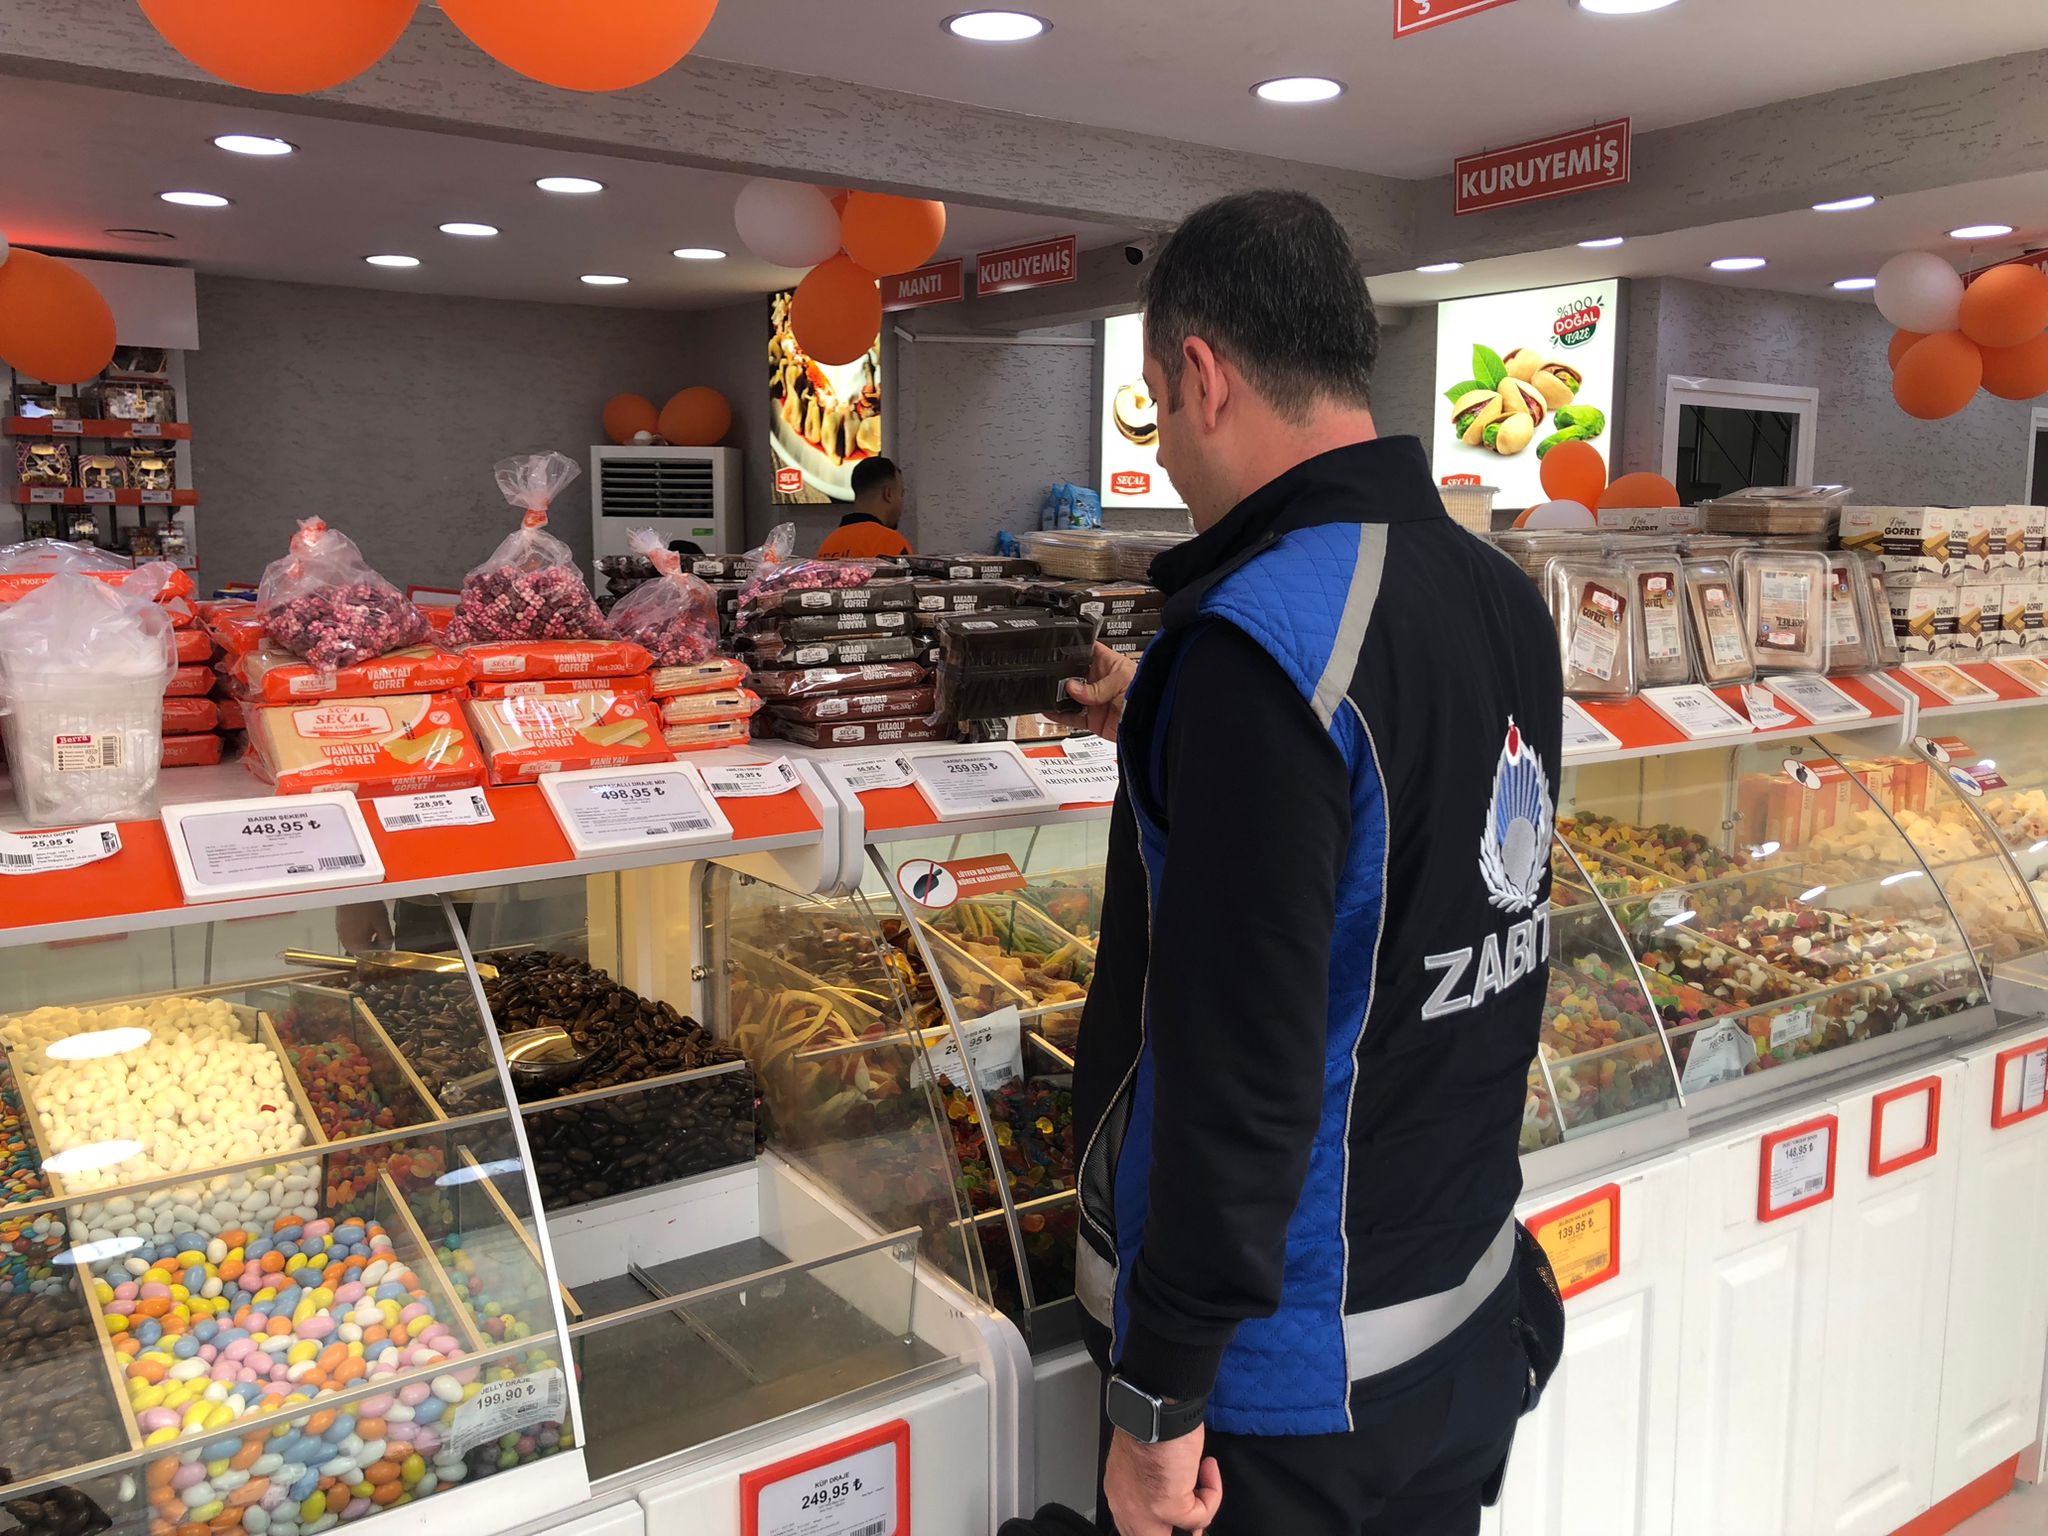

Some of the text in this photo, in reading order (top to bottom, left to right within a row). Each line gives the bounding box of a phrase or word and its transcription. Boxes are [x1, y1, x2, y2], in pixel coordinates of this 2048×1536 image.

[1461, 134, 1620, 199] KURUYEMİŞ
[980, 245, 1071, 284] KURUYEMİŞ
[898, 274, 942, 298] MANTI
[1557, 296, 1593, 319] %100
[1555, 311, 1598, 333] DOĞAL
[1564, 327, 1592, 344] TAZE
[1115, 475, 1145, 487] SEÇAL
[1884, 527, 1922, 537] GOFRET
[841, 590, 871, 599] KAKAOLU
[953, 595, 978, 603] KAKAOLU
[844, 599, 868, 608] GOFRET
[1112, 600, 1135, 608] KAKAOLU
[1891, 608, 1908, 616] RET
[1106, 621, 1132, 629] KAKAOLU
[838, 645, 868, 654] KAKAOLU
[1112, 643, 1136, 651] KAKAOLU
[840, 654, 865, 663] GOFRET
[558, 663, 590, 673] GOFRET
[863, 671, 887, 681] GOFRET
[373, 678, 406, 690] GOFRET
[861, 703, 885, 714] GOFRET
[315, 712, 370, 727] SEÇAL
[876, 722, 905, 731] KAKAOLU
[59, 735, 90, 744] Berra
[878, 730, 902, 740] GOFRET
[535, 737, 574, 748] GOFRET
[322, 743, 381, 756] VANİLYALI
[332, 753, 376, 767] GOFRET
[947, 762, 988, 773] 259,95
[394, 782, 428, 792] GOFRET
[601, 786, 665, 801] 498,95 ₺
[414, 800, 445, 809] 228,95
[248, 812, 308, 823] BADEM ŞEKERİ
[242, 819, 321, 836] 448,95 ₺
[32, 838, 63, 848] 25,95
[1785, 1143, 1808, 1159] 148,95
[1558, 1220, 1586, 1240] 139,95
[481, 1377, 531, 1395] JELLY DRAJE
[476, 1388, 522, 1411] 199,90
[814, 1471, 850, 1489] KÜP DRAJE
[801, 1482, 849, 1510] 249,95
